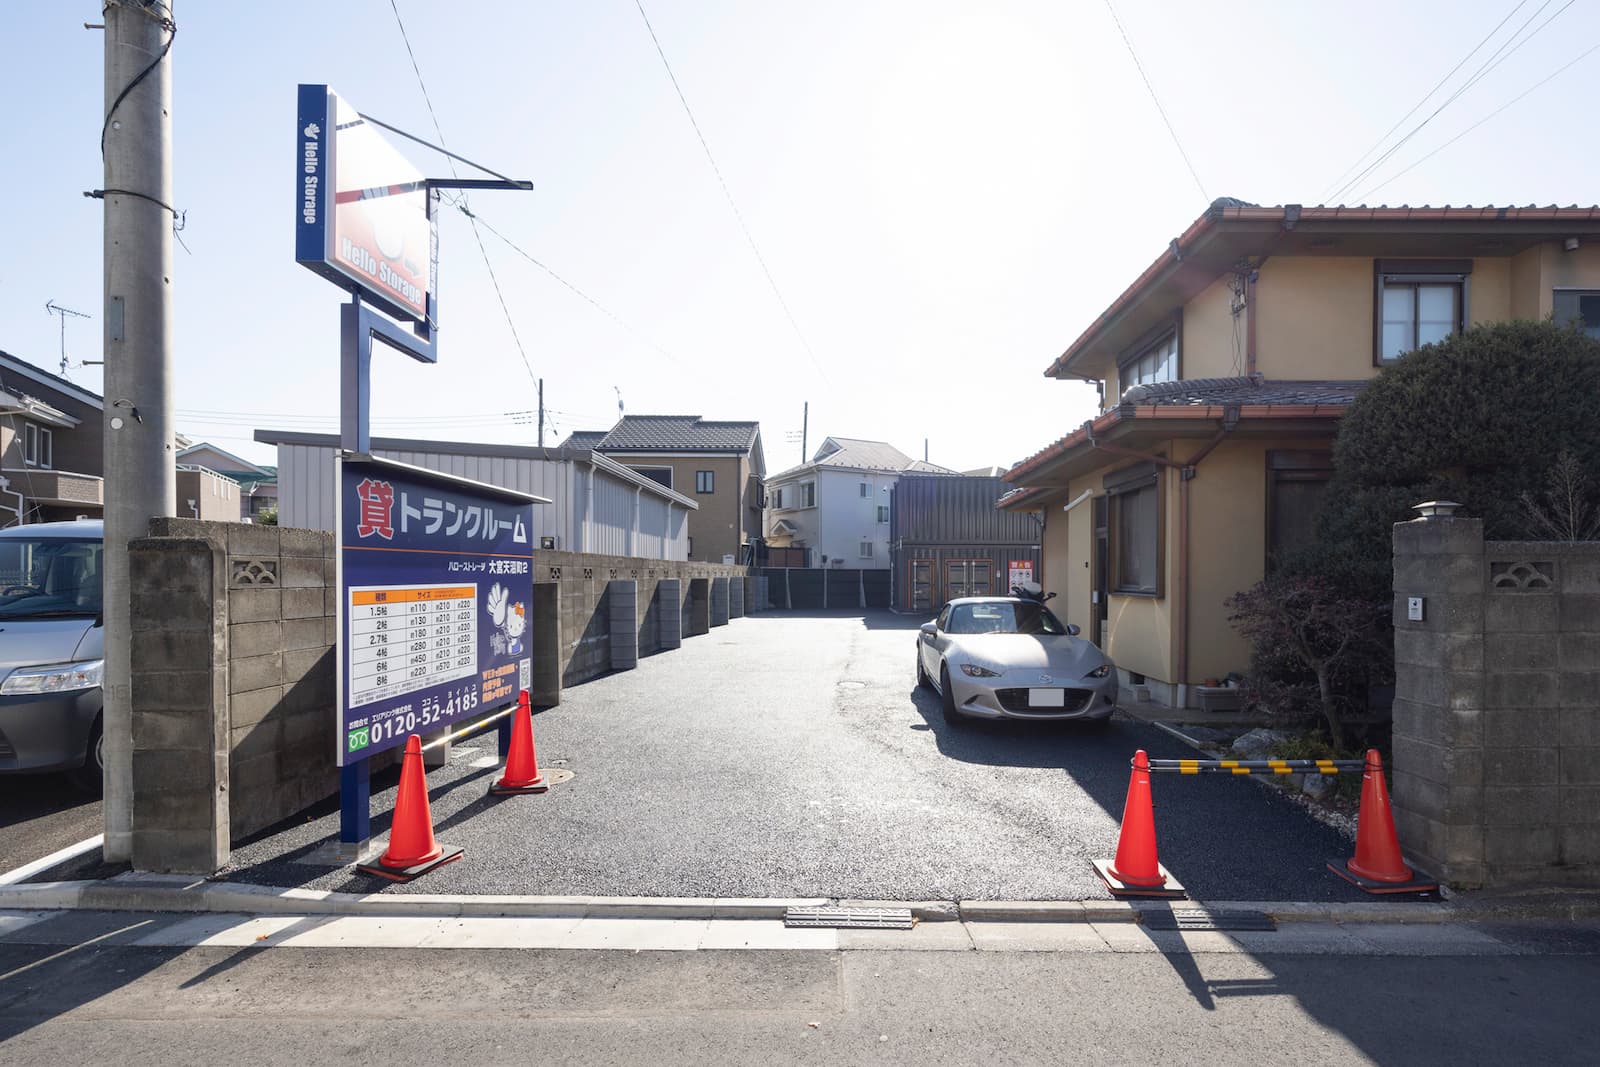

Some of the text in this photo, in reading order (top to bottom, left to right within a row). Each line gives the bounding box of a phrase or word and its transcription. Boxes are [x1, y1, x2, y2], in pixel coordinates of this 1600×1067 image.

[304, 141, 318, 225] Hello Storage
[341, 237, 421, 305] Hello Storage
[371, 692, 478, 744] 0120-52-4185
